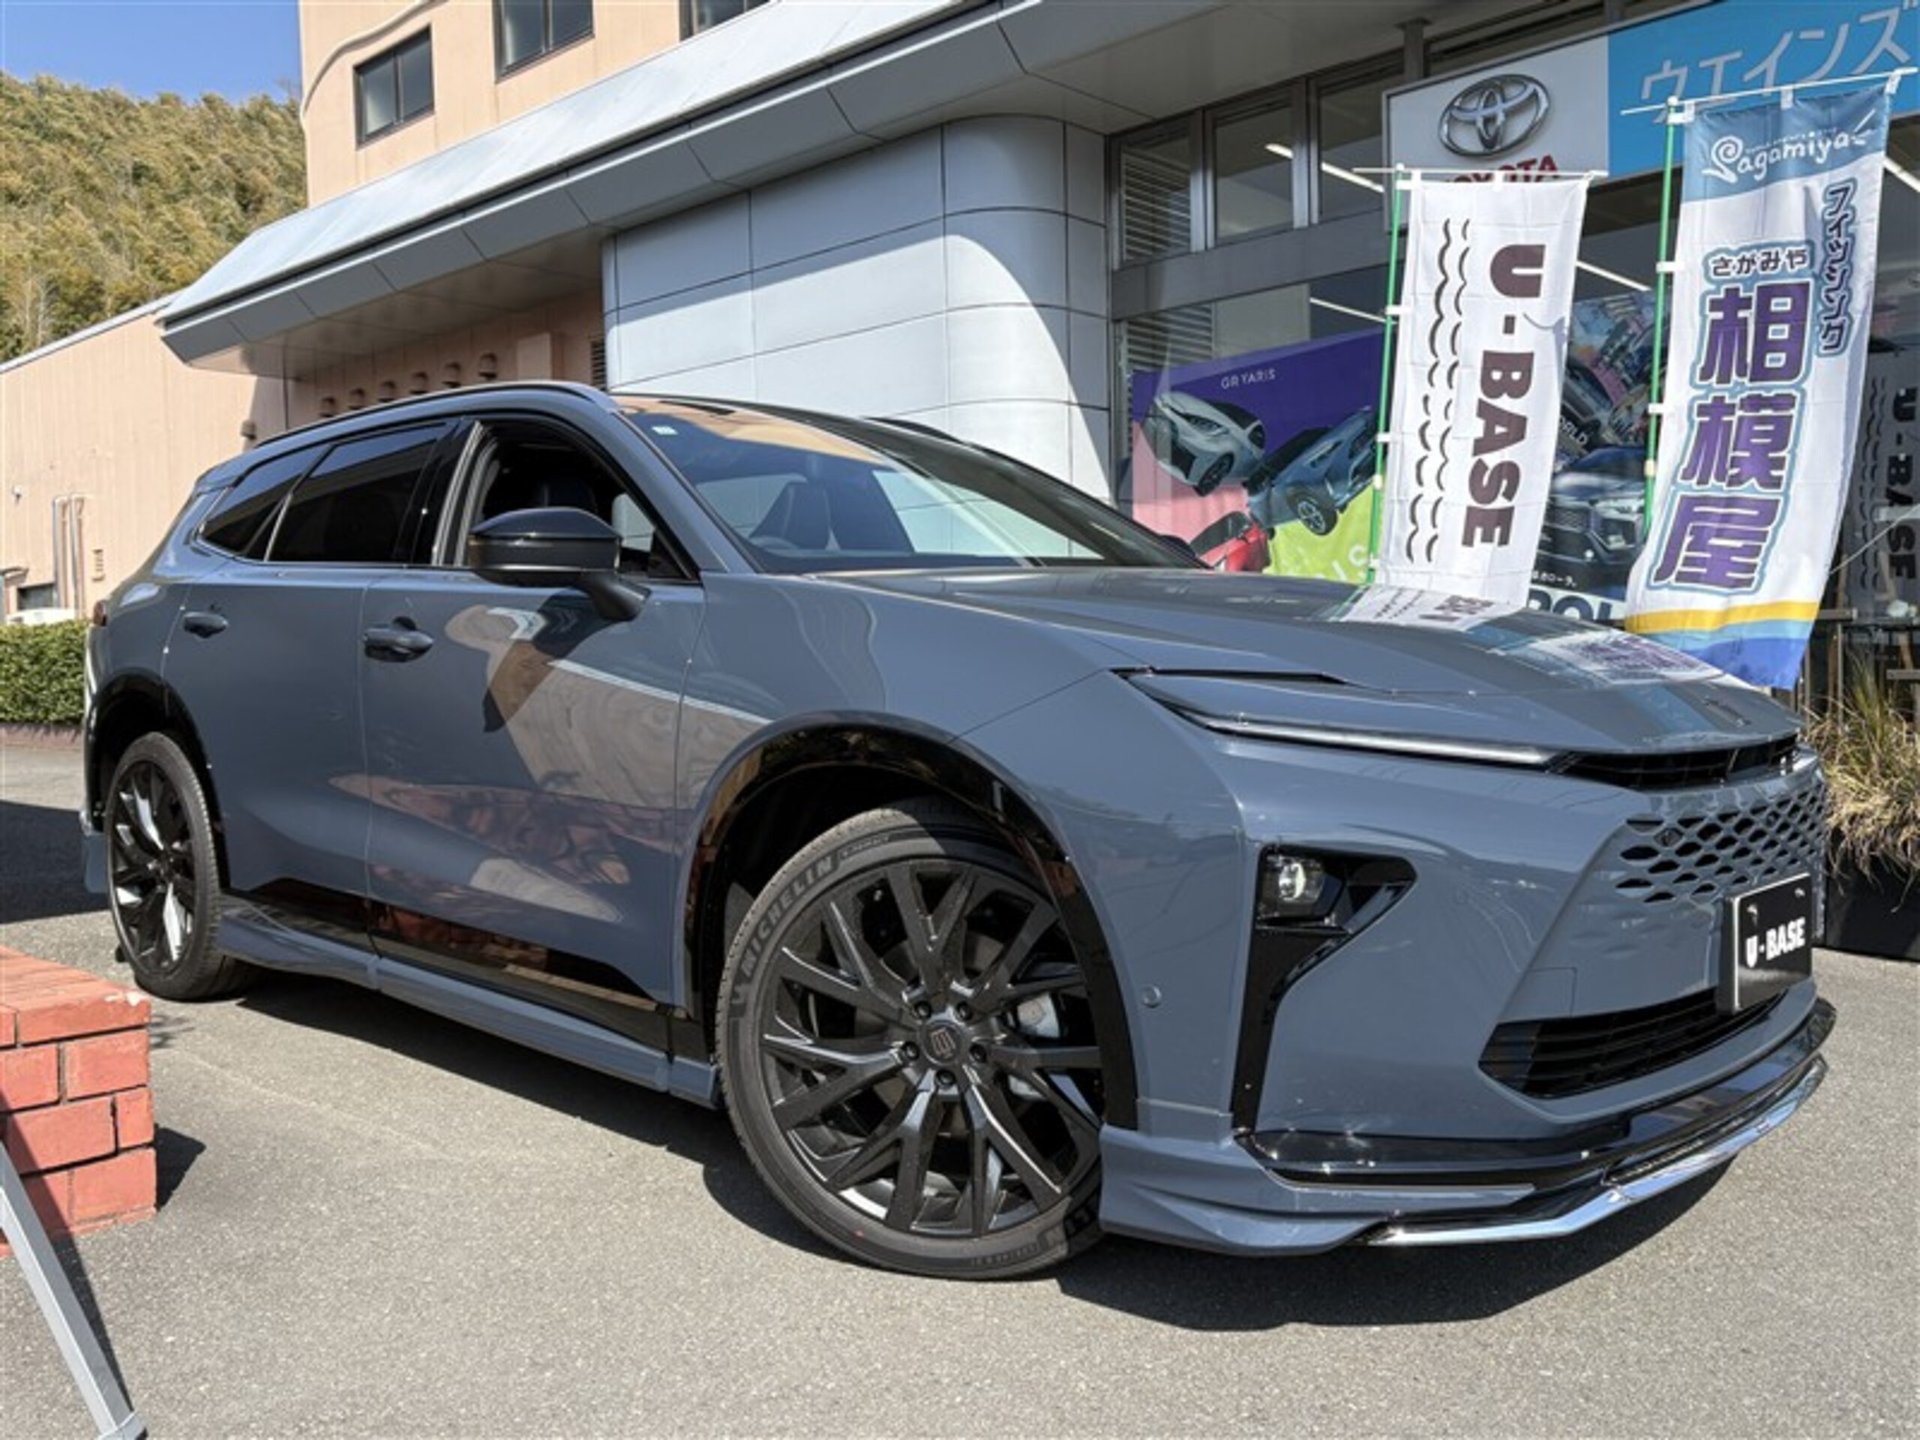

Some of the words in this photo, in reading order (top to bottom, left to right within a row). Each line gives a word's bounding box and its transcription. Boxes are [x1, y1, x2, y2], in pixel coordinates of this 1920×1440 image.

[1712, 248, 1807, 277] さがみや
[1652, 283, 1810, 590] 相模屋
[741, 855, 836, 978] MICHELIN
